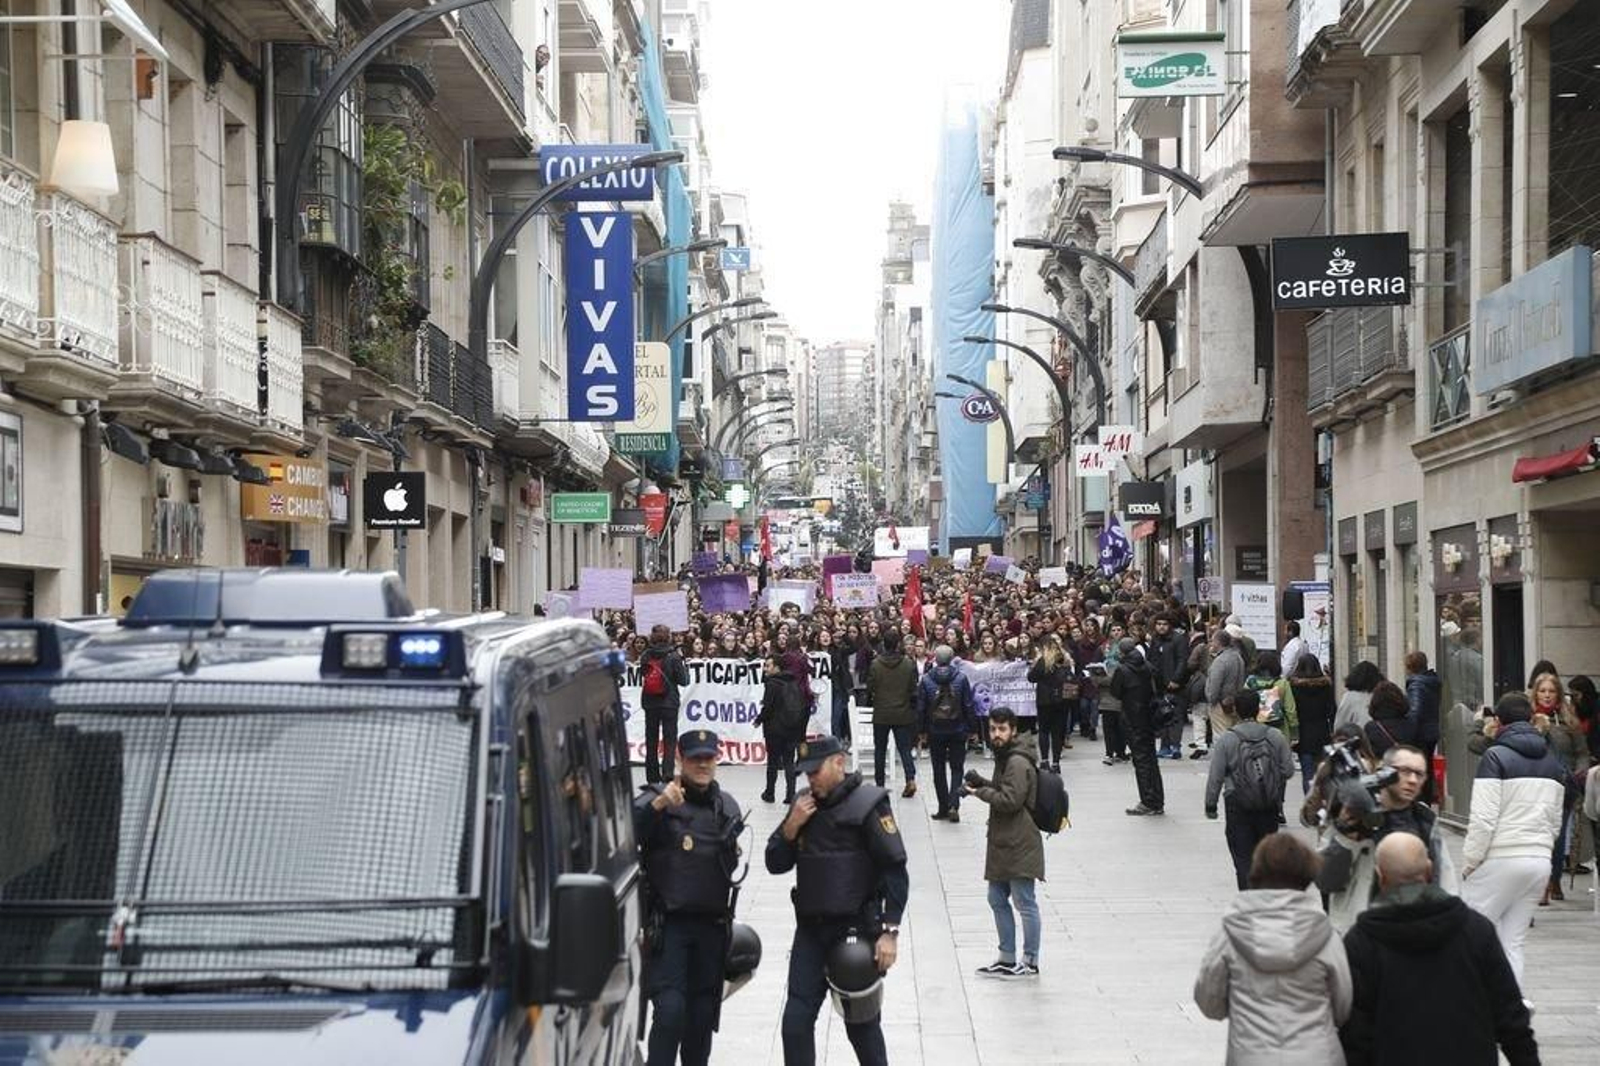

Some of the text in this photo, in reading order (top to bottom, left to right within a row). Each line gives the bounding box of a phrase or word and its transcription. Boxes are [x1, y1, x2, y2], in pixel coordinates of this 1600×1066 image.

[546, 156, 646, 188] COLEXIO
[580, 217, 619, 416] VIVAS
[635, 365, 667, 378] RTAL
[967, 400, 994, 415] C&A
[620, 434, 667, 451] RESIDENCIA
[1103, 433, 1131, 452] H&M
